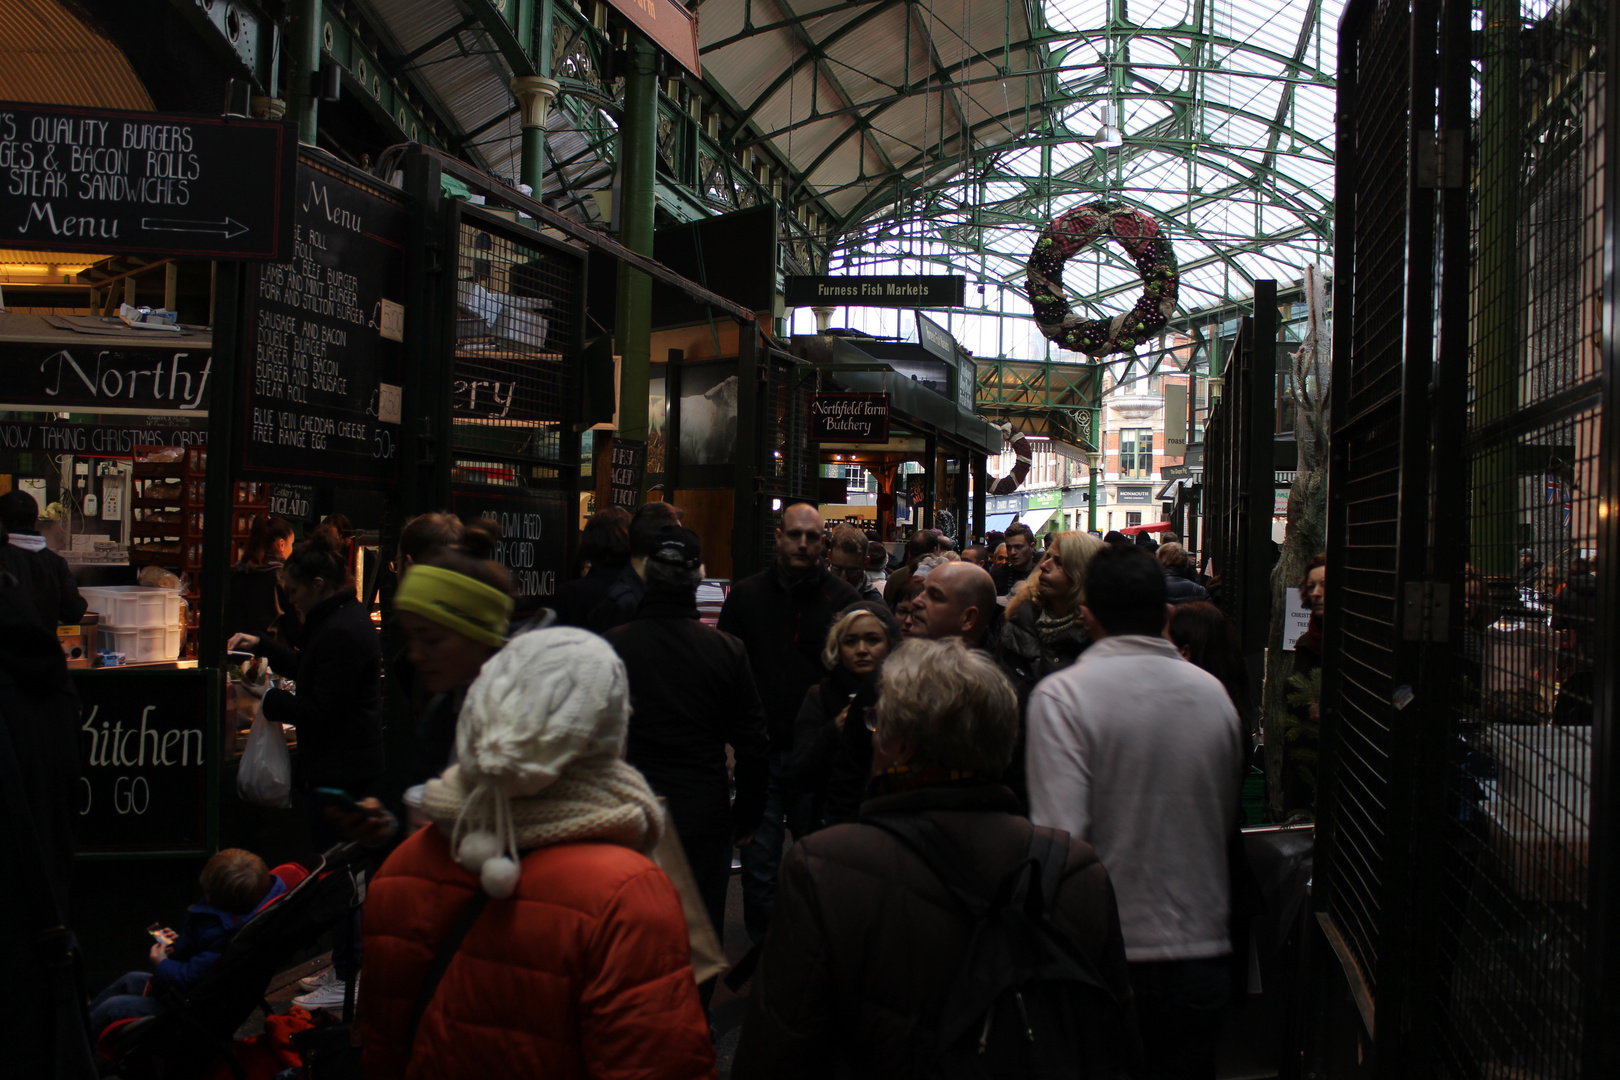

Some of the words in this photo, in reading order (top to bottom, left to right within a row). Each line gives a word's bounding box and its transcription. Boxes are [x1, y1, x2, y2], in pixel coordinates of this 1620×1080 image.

[31, 116, 110, 146] QUALITY
[122, 123, 194, 152] BURGERS
[43, 144, 59, 171] &
[71, 146, 130, 175] BACON
[146, 151, 200, 180] ROLLS
[8, 168, 68, 198] STEAK
[79, 173, 190, 206] SANDWICHES
[18, 201, 120, 239] Menu
[302, 181, 362, 233] Menu
[294, 240, 314, 262] ROLL
[309, 229, 328, 251] ROLL
[260, 263, 284, 286] LAMB
[287, 272, 304, 292] AND
[305, 278, 325, 297] MINT
[328, 284, 358, 308] BURGER
[303, 260, 321, 280] BEEF
[327, 267, 359, 293] BURGER
[818, 283, 858, 297] Furness
[861, 283, 883, 297] Fish
[886, 283, 929, 297] Markets
[260, 281, 282, 303] PORK
[284, 288, 300, 307] AND
[303, 293, 336, 316] STILTON
[336, 303, 365, 326] BURGER
[257, 327, 290, 350] DOUBLE
[293, 335, 328, 358] BURGER
[258, 309, 297, 335] SAUSAGE
[301, 321, 319, 340] AND
[321, 325, 347, 347] BACON
[256, 344, 289, 366] BURGER
[291, 351, 309, 371] AND
[312, 356, 339, 377] BACON
[255, 361, 290, 384] BURGER
[291, 368, 309, 387] AND
[312, 373, 348, 396] SAUSAGE
[255, 379, 284, 400] STEAK
[287, 385, 308, 404] ROLL
[253, 407, 274, 427] BLUE
[278, 411, 297, 429] VEIN
[300, 414, 335, 435] CHEDDAR
[338, 420, 367, 441] CHEESE
[811, 400, 861, 419] Northfield
[860, 401, 889, 416] Farm
[0, 426, 32, 449] NOW
[40, 426, 86, 451] TAKING
[92, 428, 164, 452] CHRISTMAS
[171, 430, 208, 447] ORDE
[252, 425, 274, 444] FREE
[278, 428, 306, 448] RANGE
[311, 433, 327, 450] EGG
[822, 416, 872, 436] Butchery
[612, 447, 633, 466] DRY
[268, 496, 310, 517] NGLAND
[501, 512, 520, 538] OWN
[522, 513, 542, 540] AGED
[517, 570, 555, 597] SANDWICH
[114, 776, 149, 815] GO
